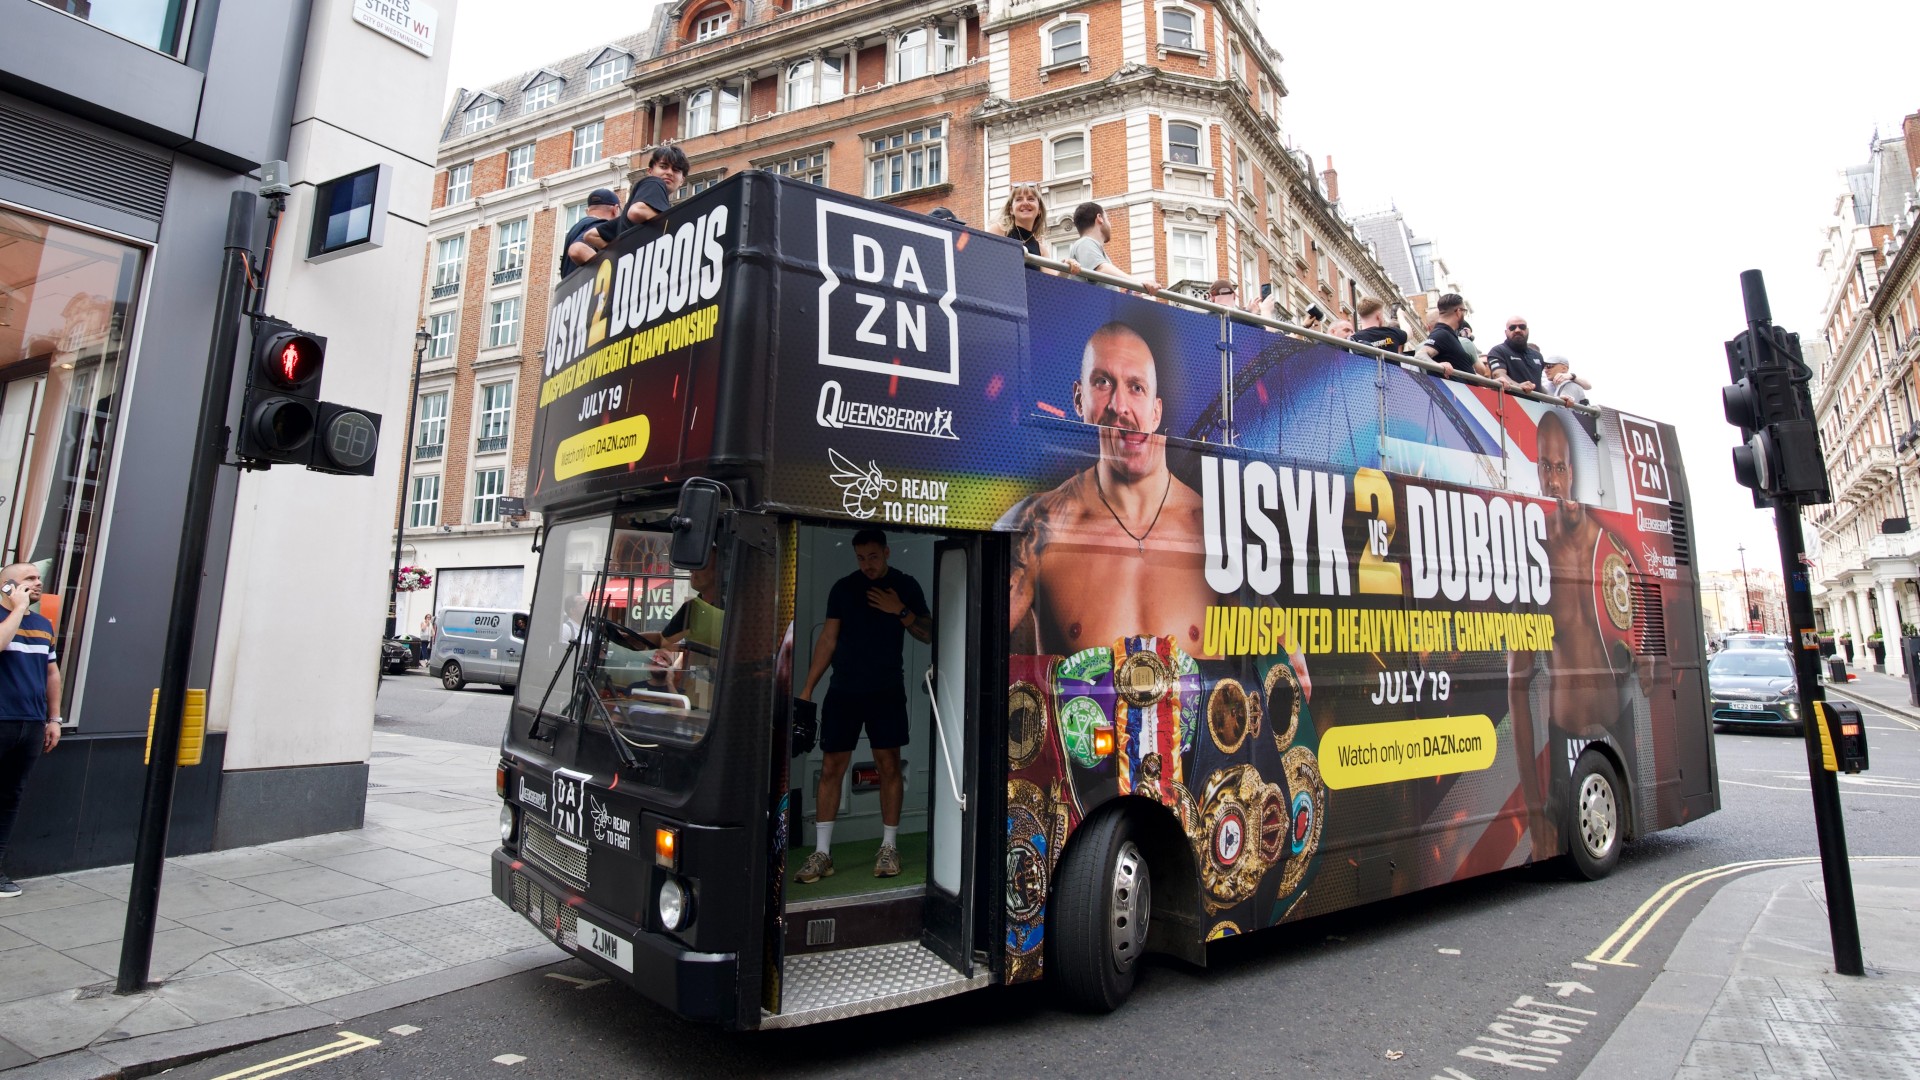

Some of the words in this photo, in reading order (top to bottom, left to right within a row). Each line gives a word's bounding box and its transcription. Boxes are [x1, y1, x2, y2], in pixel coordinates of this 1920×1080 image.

[362, 14, 376, 25] CITY
[377, 21, 384, 29] OF
[384, 24, 424, 50] WESTMINSTER
[365, 0, 411, 28] STREET
[413, 20, 430, 39] W1
[545, 278, 594, 376] USYK
[587, 258, 612, 348] 2
[610, 204, 729, 338] DUBOIS
[539, 364, 577, 409] UNDISPUTED
[574, 337, 632, 385] HEAVYWEIGHT
[630, 304, 719, 365] CHAMPIONSHIP
[578, 388, 608, 422] JULY
[607, 384, 623, 411] 19
[560, 448, 576, 467] Watch
[575, 445, 587, 463] only
[587, 443, 596, 457] on
[595, 433, 638, 455] DAZN.com
[901, 478, 949, 501] READY
[882, 501, 902, 523] TO
[906, 503, 949, 525] FIGHT
[1201, 455, 1351, 596] USYK
[1353, 466, 1403, 595] 2
[1405, 484, 1552, 606] DUBOIS
[637, 589, 671, 603] IVE
[1202, 606, 1333, 657] UNDISPUTED
[1337, 608, 1452, 654] HEAVYWEIGHT
[1454, 611, 1555, 652] CHAMPIONSHIP
[1371, 670, 1425, 706] JULY
[1429, 670, 1450, 701] 19
[1842, 725, 1858, 735] WAIT
[1337, 742, 1378, 767] Watch
[1380, 739, 1405, 765] only
[1406, 744, 1420, 760] on
[1423, 734, 1482, 757] DAZN.com
[607, 830, 614, 846] TO
[614, 834, 631, 851] FIGHT
[612, 815, 631, 834] READY
[1456, 995, 1598, 1072] RIGHT
